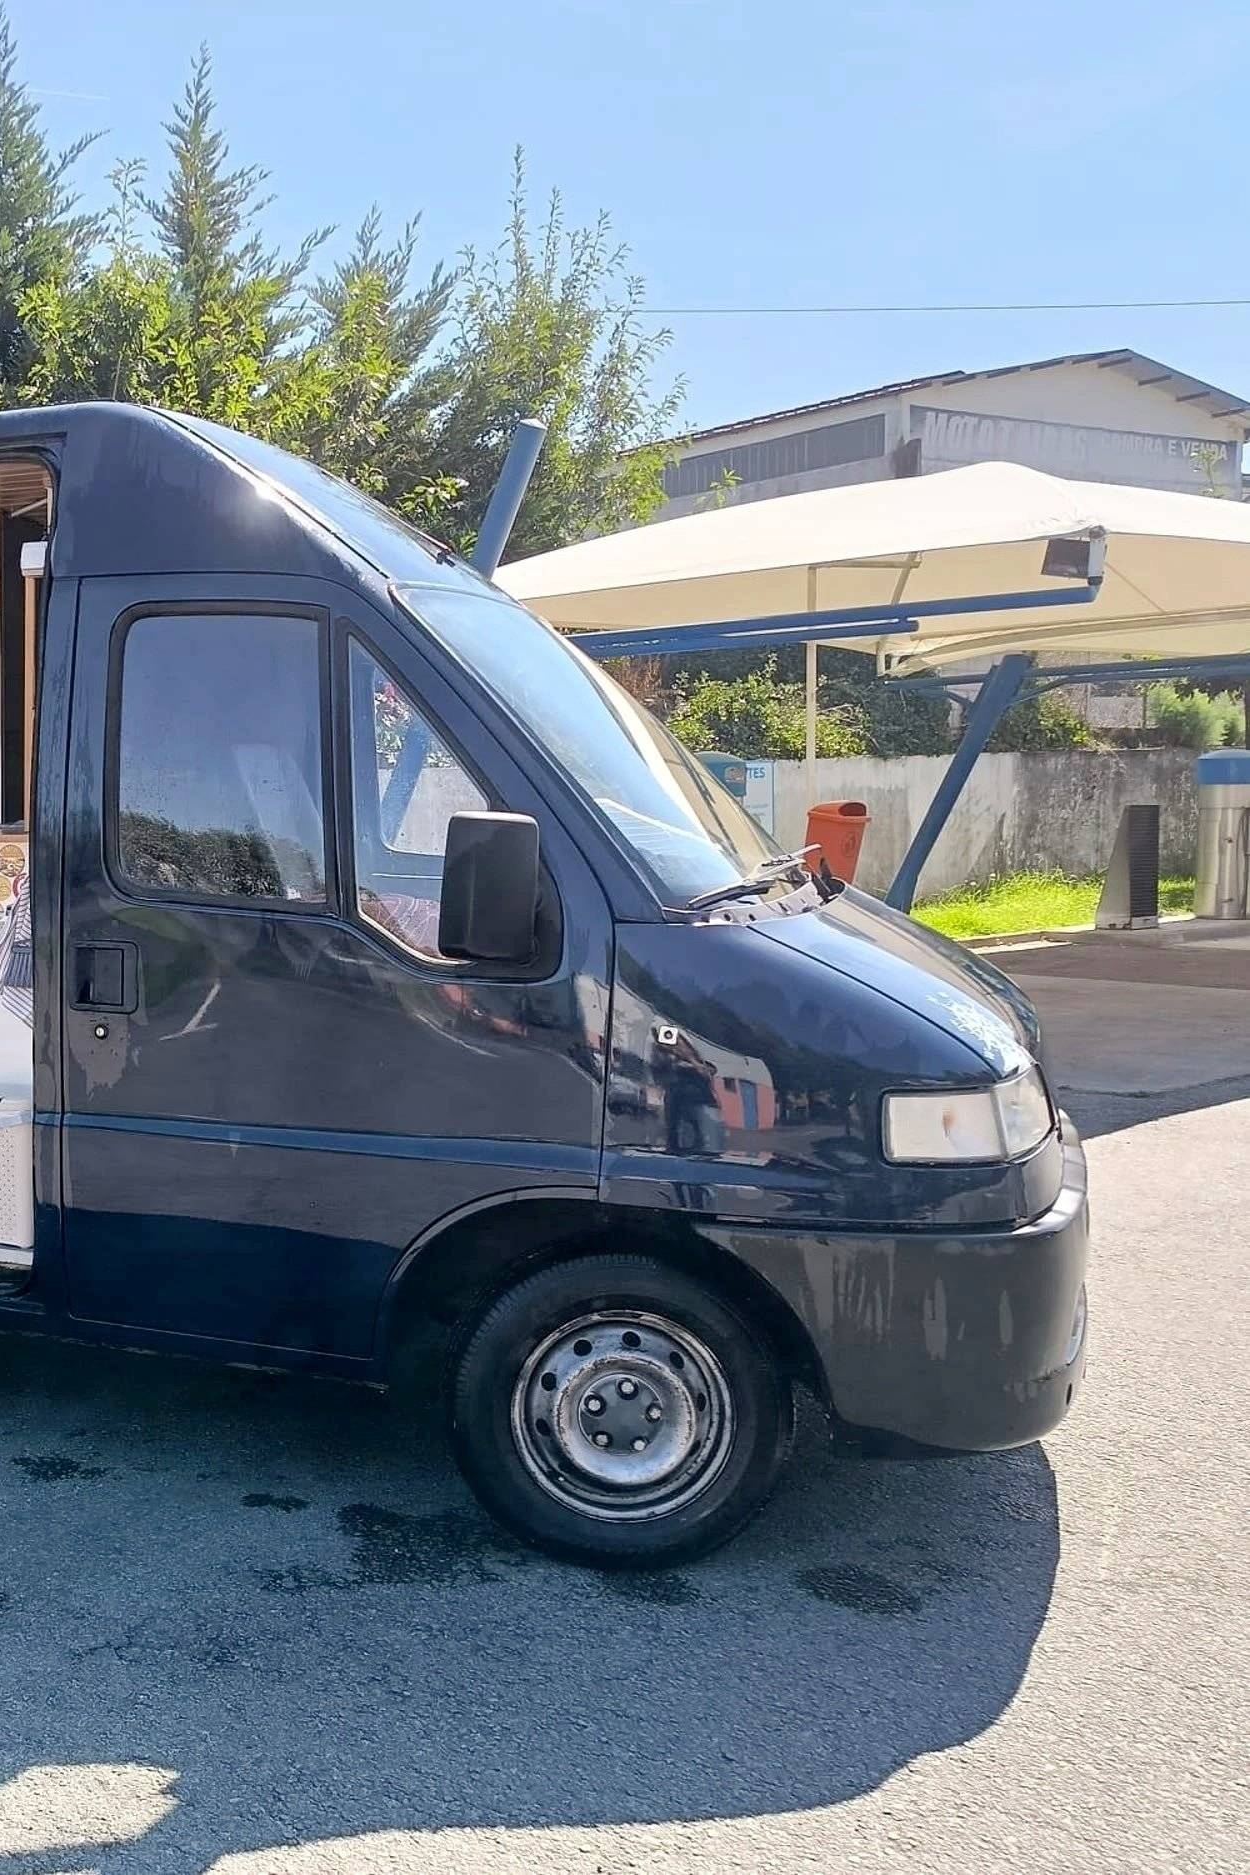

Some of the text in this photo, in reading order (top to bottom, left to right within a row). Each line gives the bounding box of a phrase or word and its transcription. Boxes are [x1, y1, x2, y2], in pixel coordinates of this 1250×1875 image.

[1101, 431, 1163, 453] COMPRA
[1168, 440, 1177, 456] E
[1181, 441, 1228, 461] VENDA
